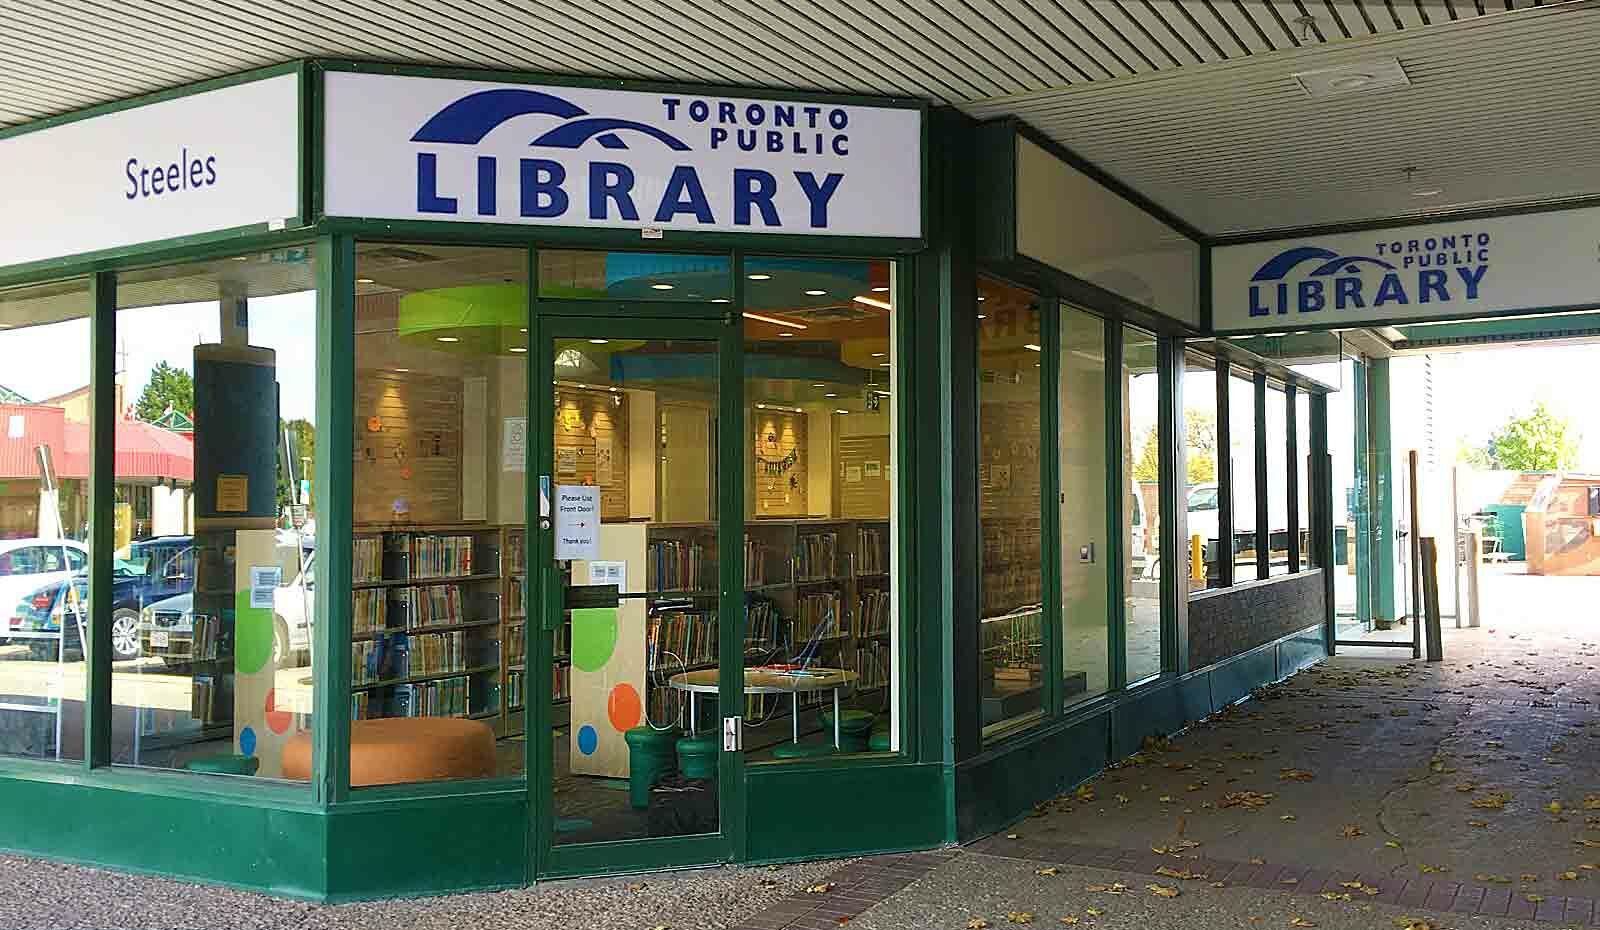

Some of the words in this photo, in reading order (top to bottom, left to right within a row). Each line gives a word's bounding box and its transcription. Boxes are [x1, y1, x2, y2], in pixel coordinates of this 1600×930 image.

[662, 98, 849, 130] TORONTO
[711, 128, 849, 156] PUBLIC
[126, 147, 216, 199] Steeles
[417, 152, 844, 229] LIBRARY
[1376, 233, 1490, 256] TORONTO
[1403, 249, 1489, 269] PUBLIC
[1249, 265, 1488, 317] LIBRARY
[560, 505, 576, 513] Front
[561, 494, 580, 502] Please
[562, 537, 579, 545] Thank
